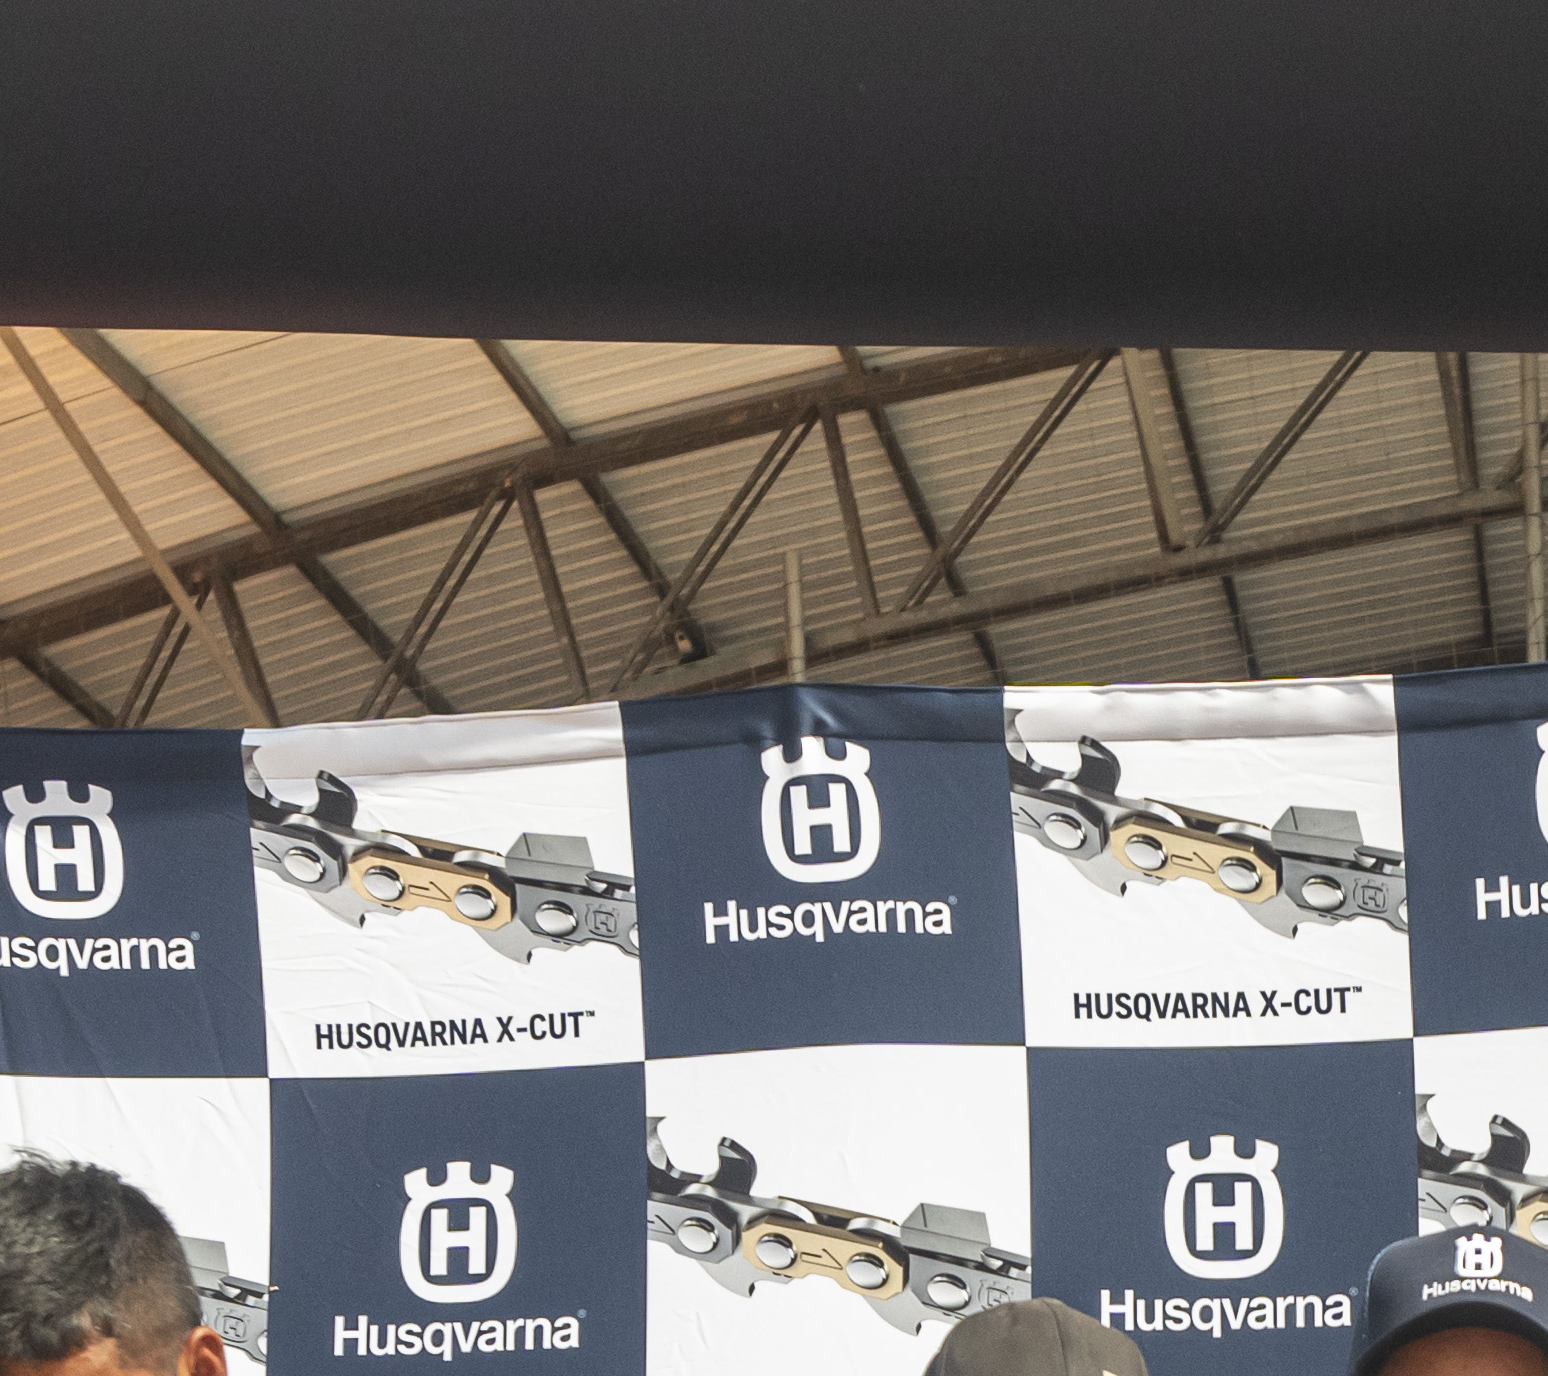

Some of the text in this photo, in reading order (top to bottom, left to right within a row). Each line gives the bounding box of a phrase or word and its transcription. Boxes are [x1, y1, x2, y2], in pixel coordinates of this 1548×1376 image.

[702, 899, 953, 944] Husqvarna
[1073, 985, 1252, 1023] HUSQVARNA
[314, 1018, 489, 1052] HUSQVARNA
[1421, 1277, 1534, 1303] Husqvarna
[1100, 1288, 1352, 1338] Husqvarna
[332, 1312, 580, 1362] Husqvarna
